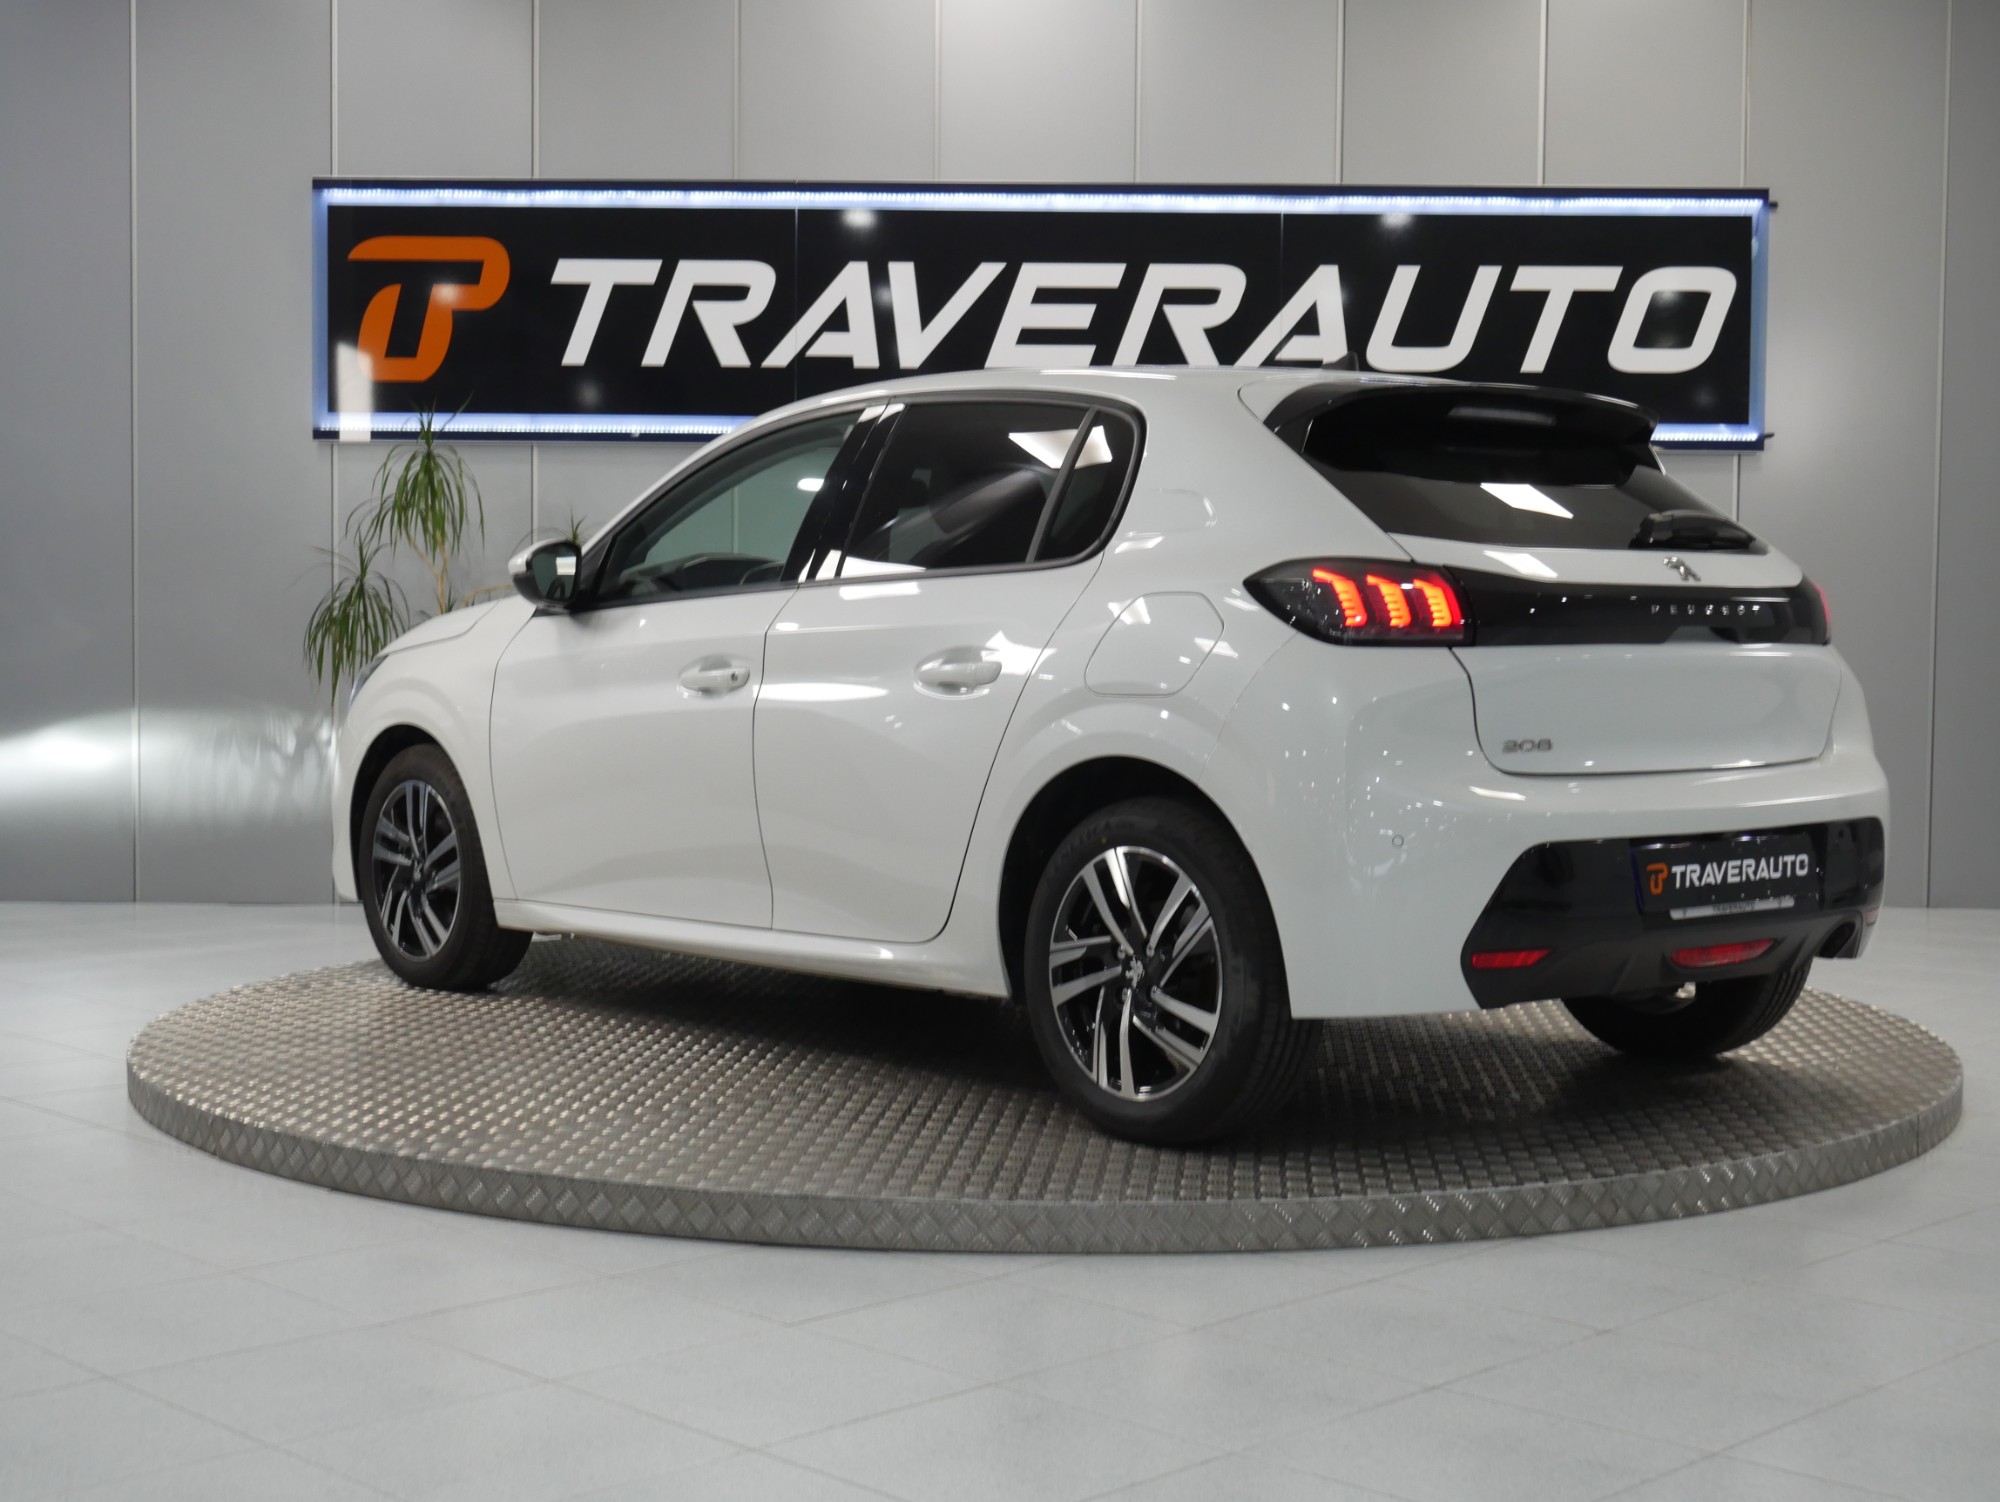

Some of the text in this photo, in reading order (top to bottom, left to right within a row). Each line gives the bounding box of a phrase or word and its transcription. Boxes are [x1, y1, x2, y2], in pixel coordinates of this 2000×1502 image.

[551, 258, 1737, 373] TRAVERAUTO
[1651, 603, 1760, 616] PEUGEOT
[1502, 739, 1552, 753] 208
[1671, 853, 1809, 889] TRAVERAUTO
